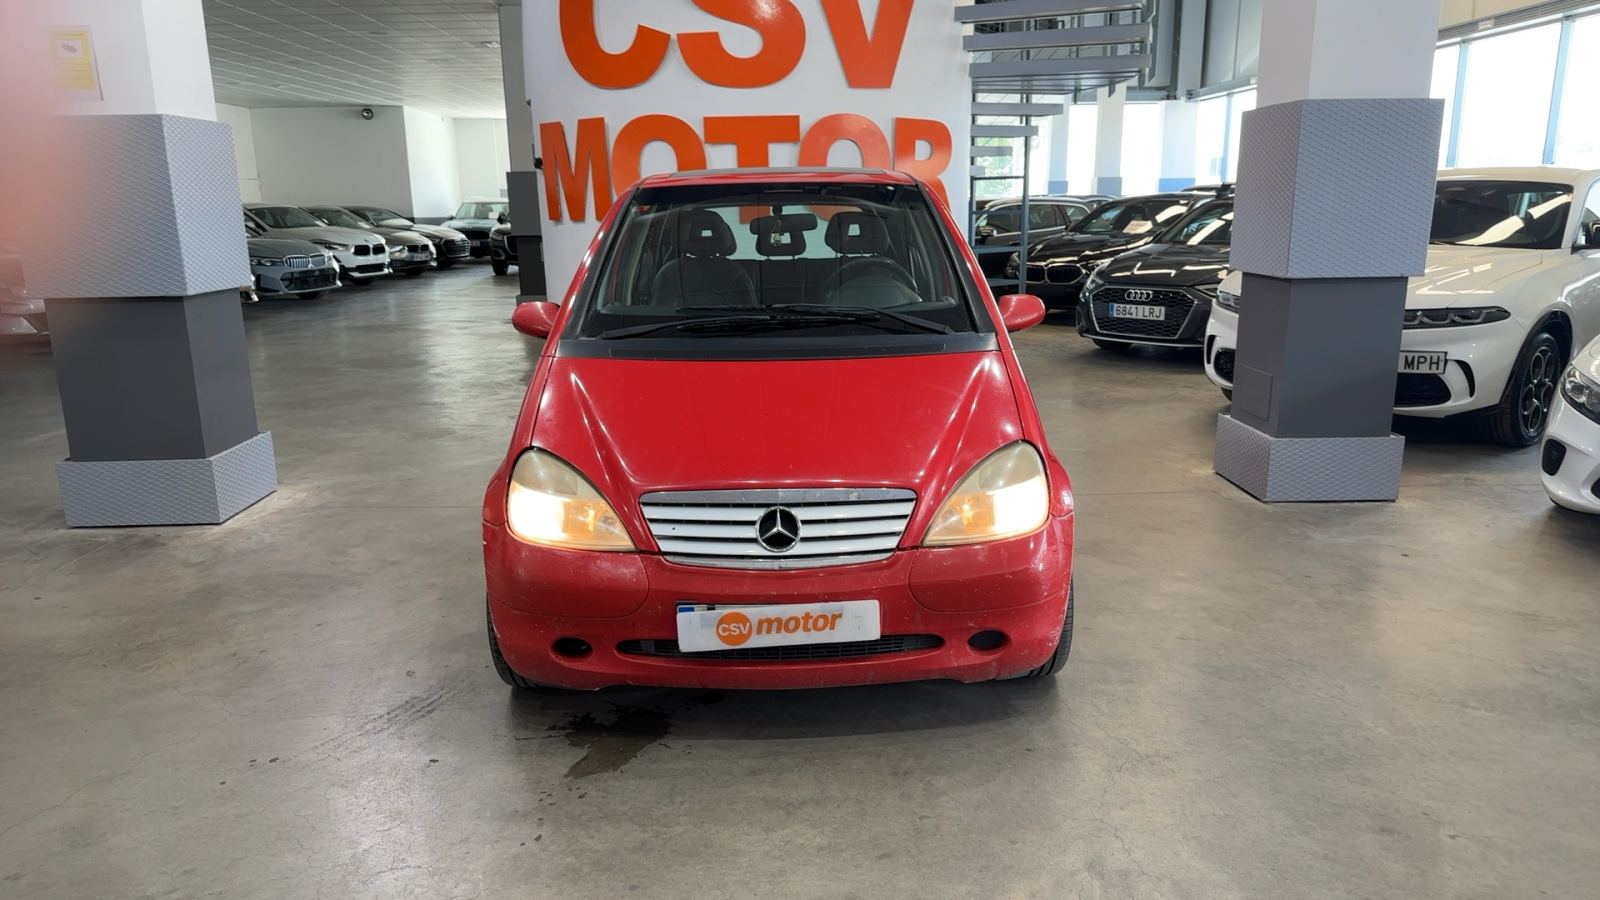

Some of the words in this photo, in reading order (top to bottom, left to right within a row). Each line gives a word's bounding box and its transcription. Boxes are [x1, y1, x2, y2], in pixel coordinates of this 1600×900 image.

[560, 0, 913, 89] CSV
[1115, 305, 1138, 317] 6841
[1142, 306, 1162, 318] LRJ
[1403, 355, 1441, 371] MPH
[718, 622, 750, 636] CSV
[756, 611, 843, 635] motor
